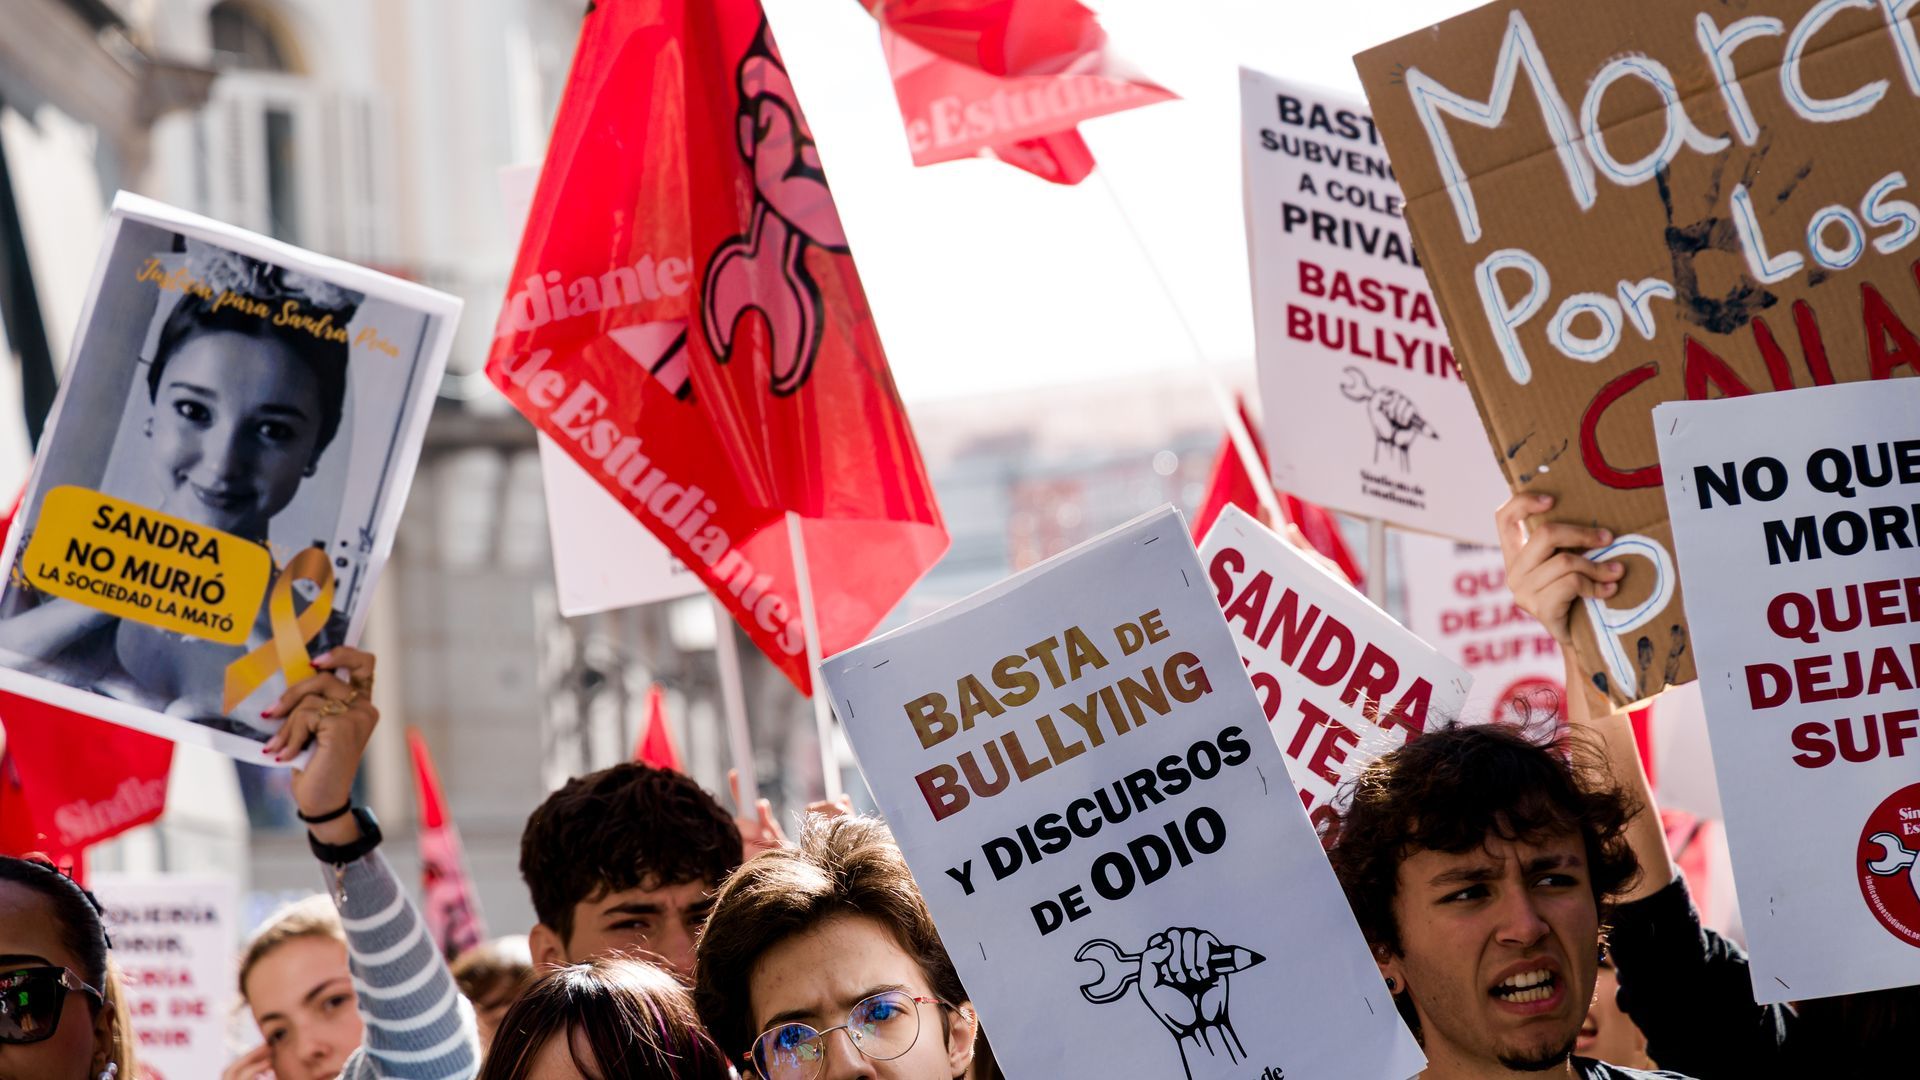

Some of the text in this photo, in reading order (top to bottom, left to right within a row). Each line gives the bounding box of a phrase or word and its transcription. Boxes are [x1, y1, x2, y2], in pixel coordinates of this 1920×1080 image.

[1260, 129, 1397, 182] SUBVEN
[1300, 173, 1317, 196] A
[1298, 260, 1437, 329] BASTA
[1475, 171, 1920, 385] Por Los
[211, 290, 269, 318] para
[272, 299, 348, 343] Sandra
[1694, 439, 1920, 510] NO QUE
[93, 505, 220, 564] SANDRA
[550, 379, 806, 656] Estudiantes
[38, 563, 234, 632] LA SOCIEDAD LA MATÓ
[65, 538, 226, 605] NO MURIÓ
[904, 608, 1171, 750] BASTA DE
[1209, 547, 1433, 742] SANDRA
[914, 651, 1213, 822] BULLYING
[1286, 698, 1362, 787] TE
[1791, 709, 1920, 769] SUF
[944, 859, 975, 896] Y
[981, 726, 1251, 881] DISCURSOS
[1030, 894, 1092, 937] DE
[1091, 806, 1227, 901] ODIO
[1865, 875, 1920, 941] sindicatodeestudiantes.ne
